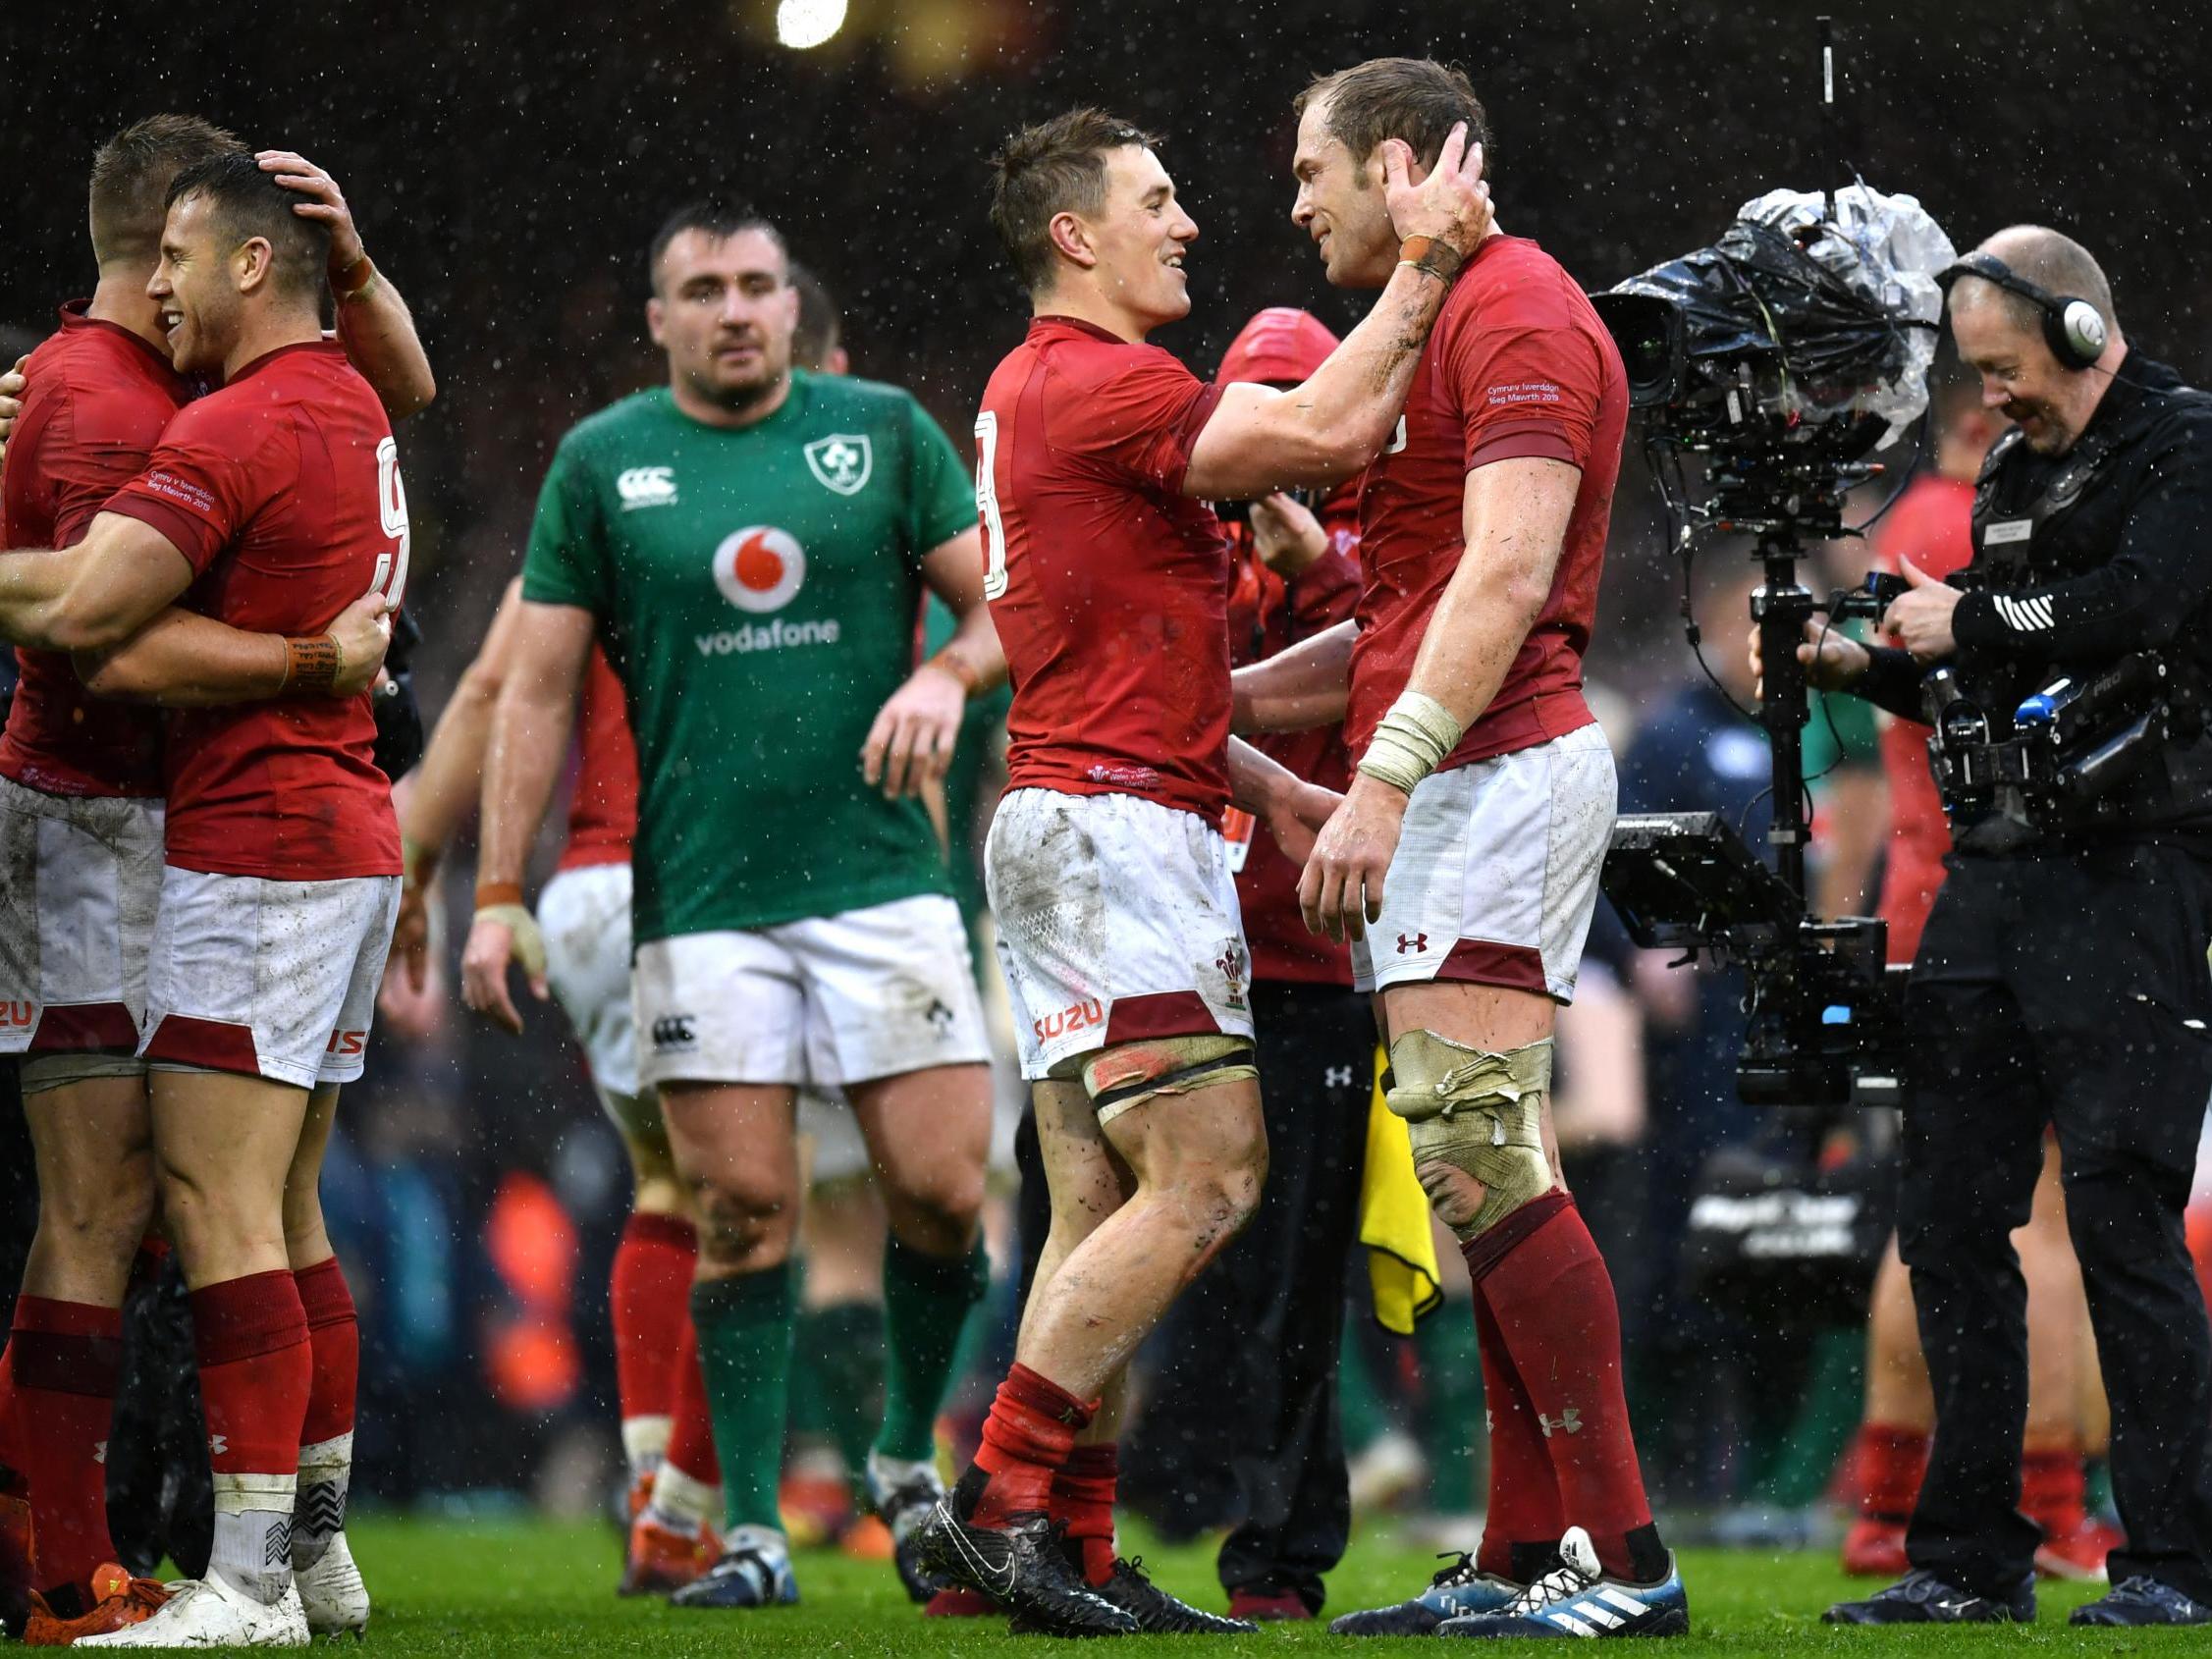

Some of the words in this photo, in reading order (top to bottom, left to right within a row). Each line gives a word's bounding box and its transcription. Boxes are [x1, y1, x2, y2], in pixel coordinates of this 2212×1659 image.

[1541, 393, 1559, 401] 2019
[369, 436, 410, 612] 9
[694, 616, 841, 658] vodafone
[1034, 997, 1103, 1046] SUZU
